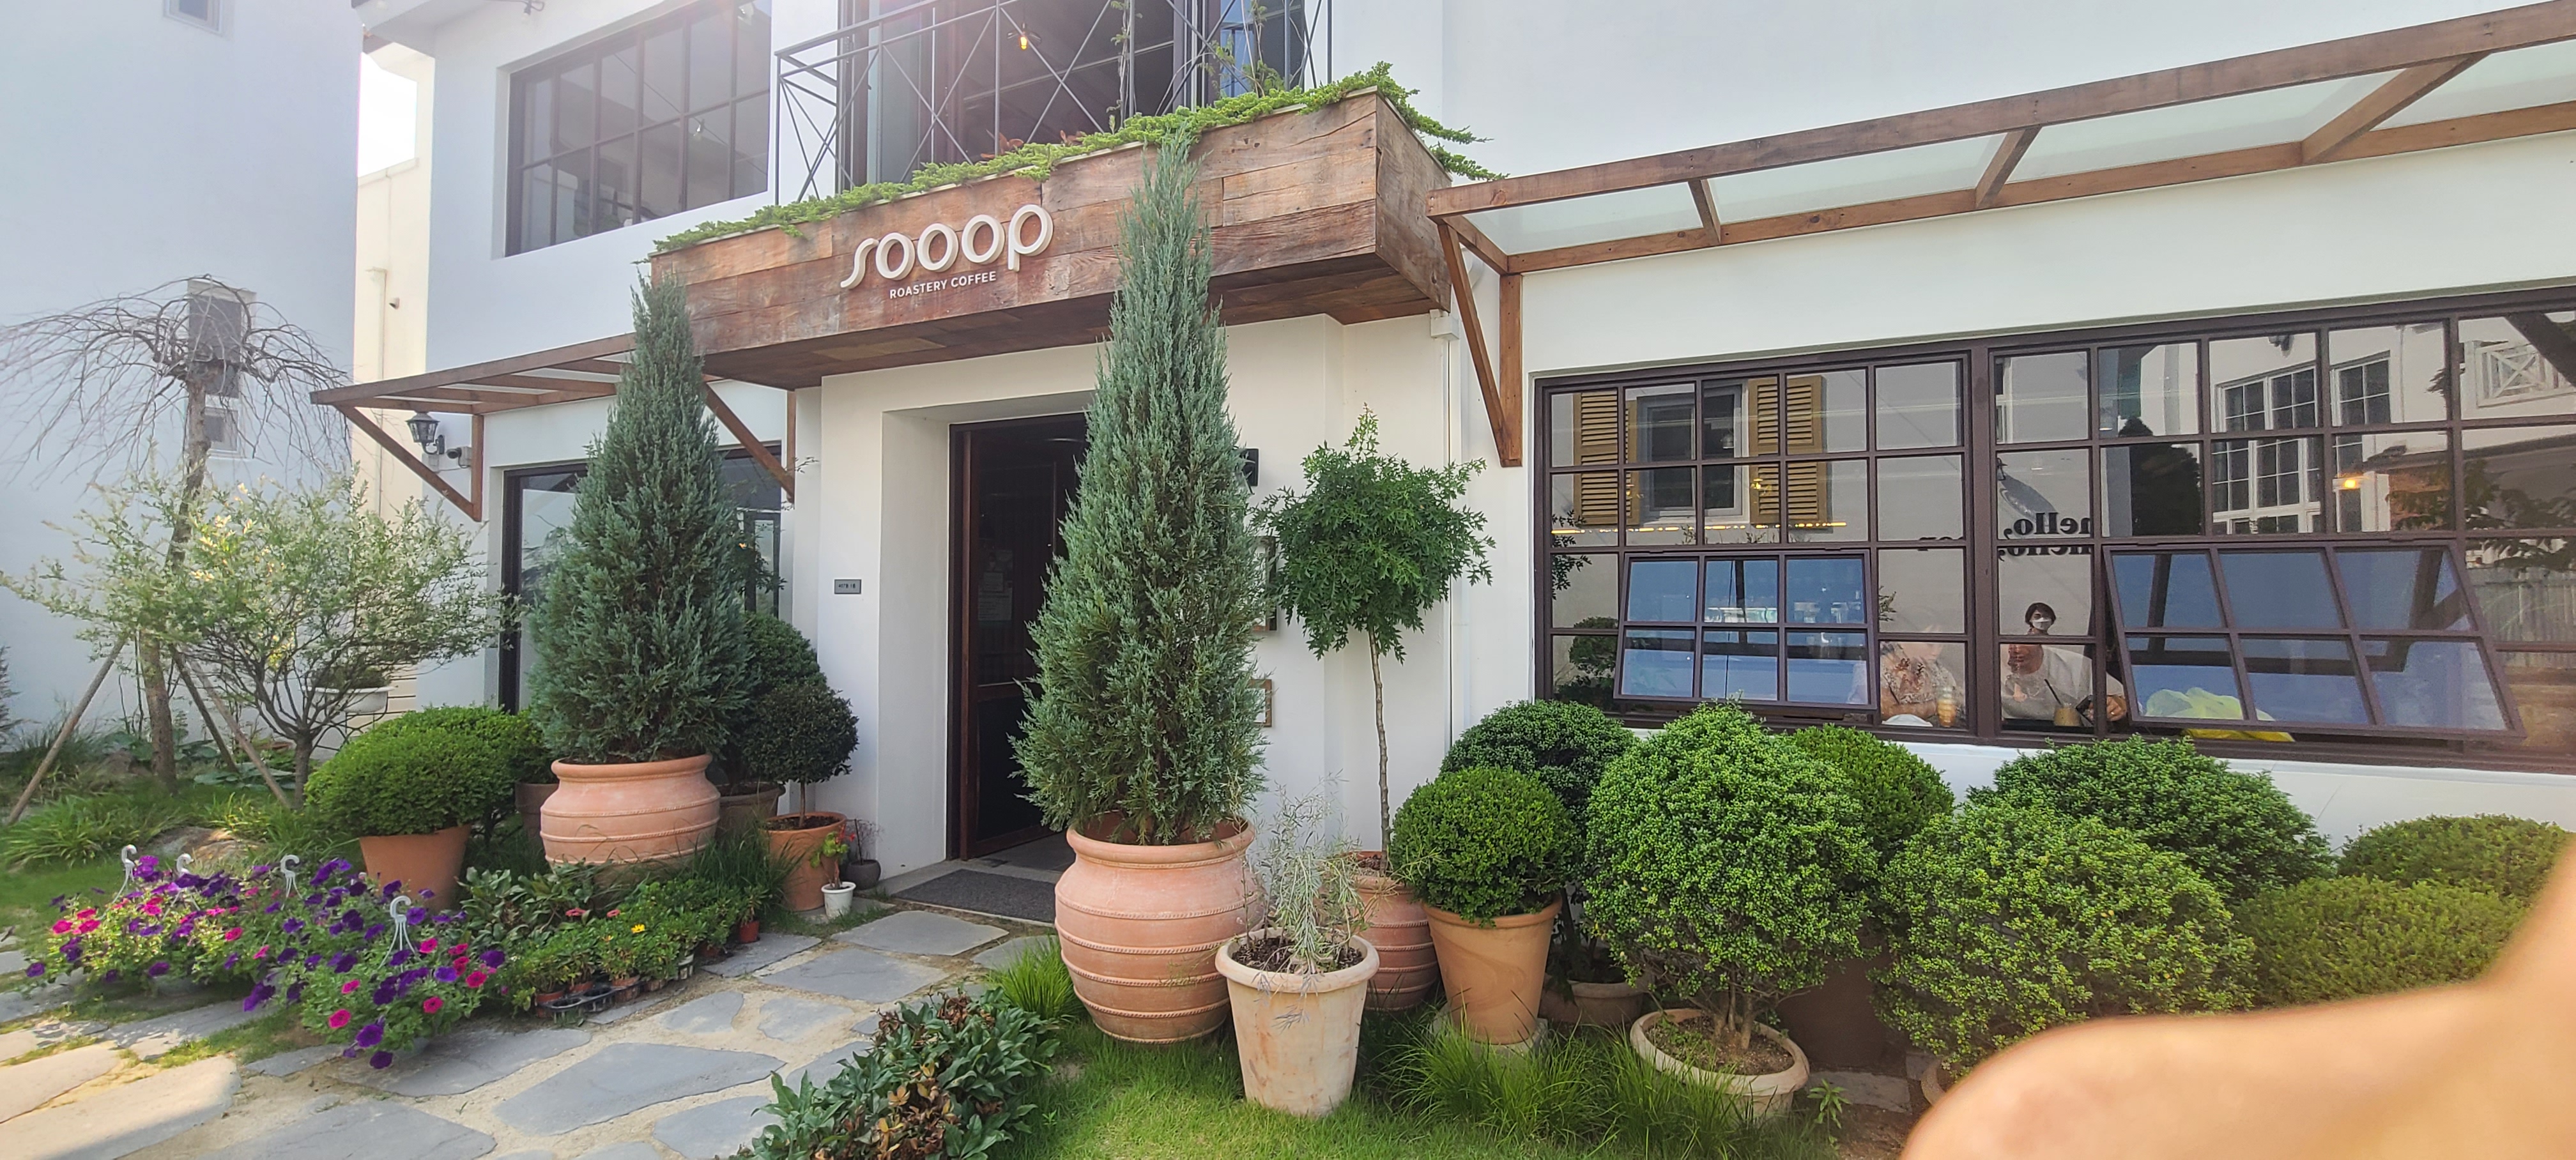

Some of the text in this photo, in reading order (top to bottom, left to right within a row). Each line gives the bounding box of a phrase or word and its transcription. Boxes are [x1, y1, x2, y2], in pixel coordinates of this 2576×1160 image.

[840, 204, 1054, 289] sooop
[889, 271, 997, 300] ROASTERY COFFEE
